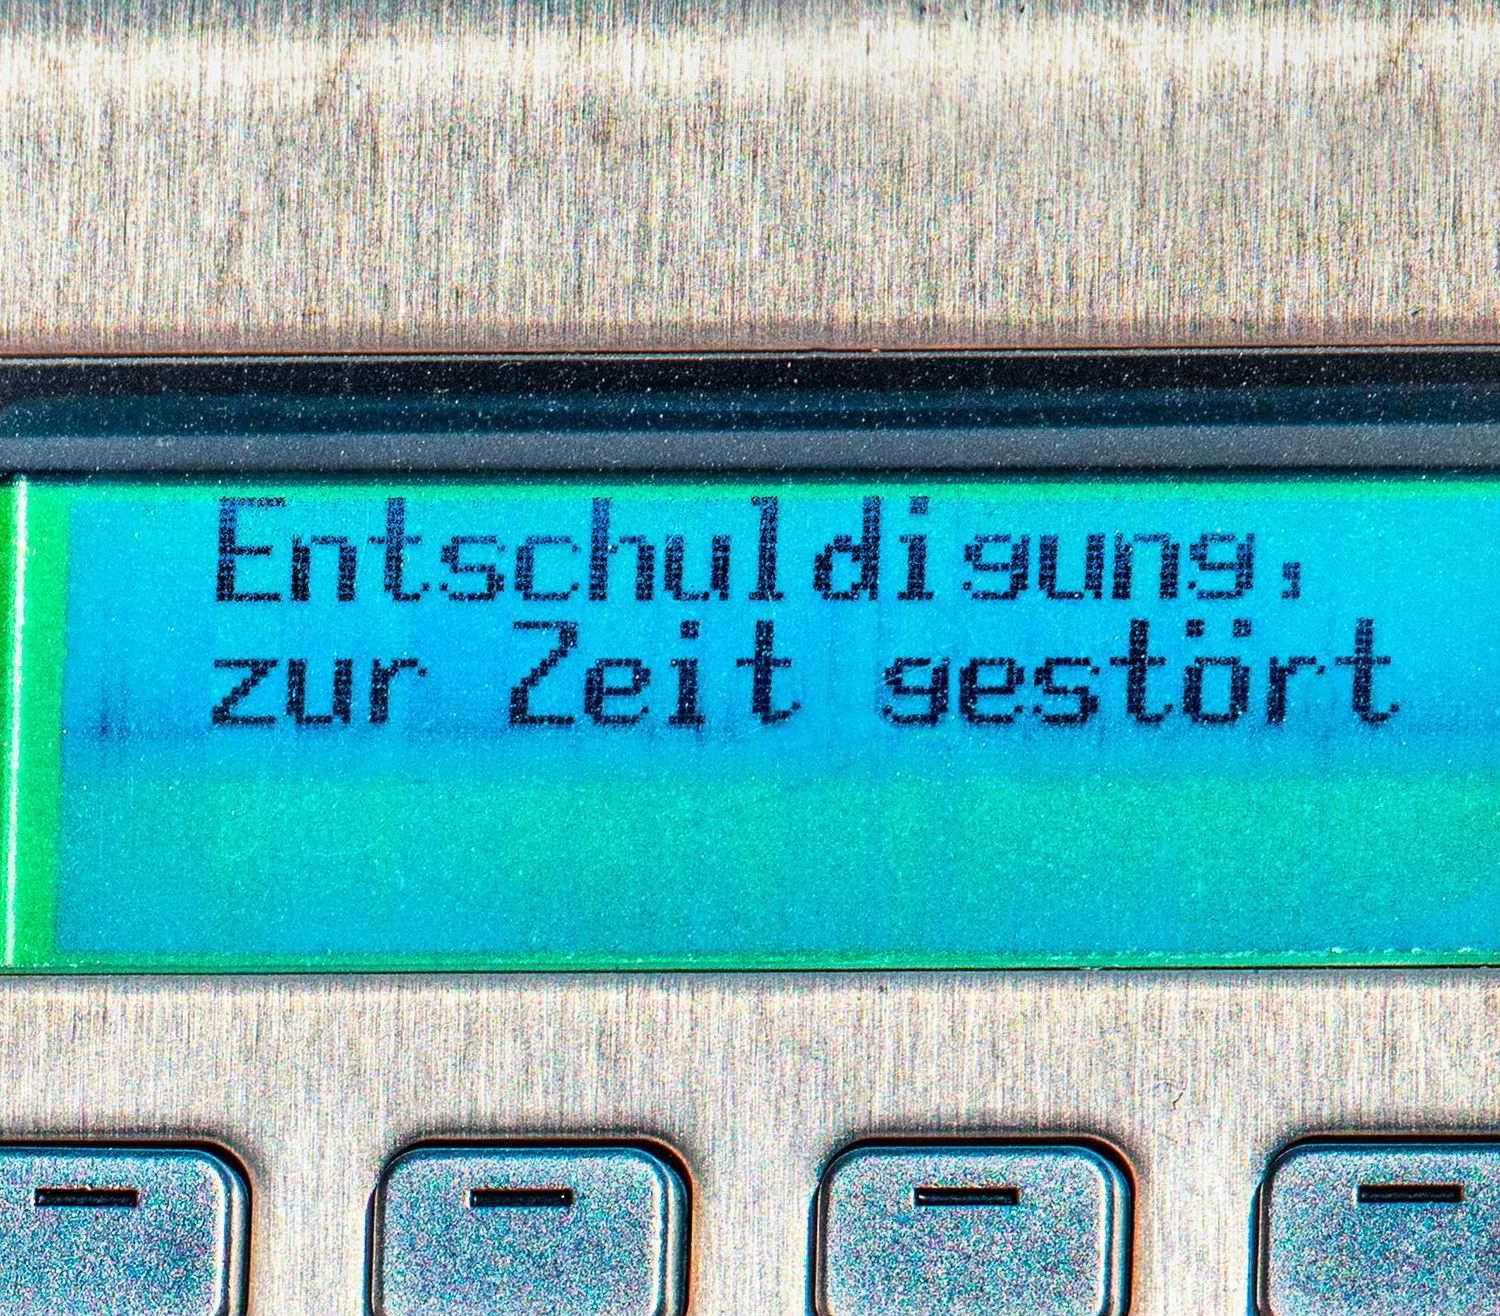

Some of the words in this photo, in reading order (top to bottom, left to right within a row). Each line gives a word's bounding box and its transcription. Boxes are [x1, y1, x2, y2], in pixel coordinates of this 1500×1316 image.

[214, 495, 1303, 602] Entschuldigung,
[210, 656, 426, 727] zur
[508, 619, 801, 727] Zeit
[883, 617, 1400, 727] gestört
